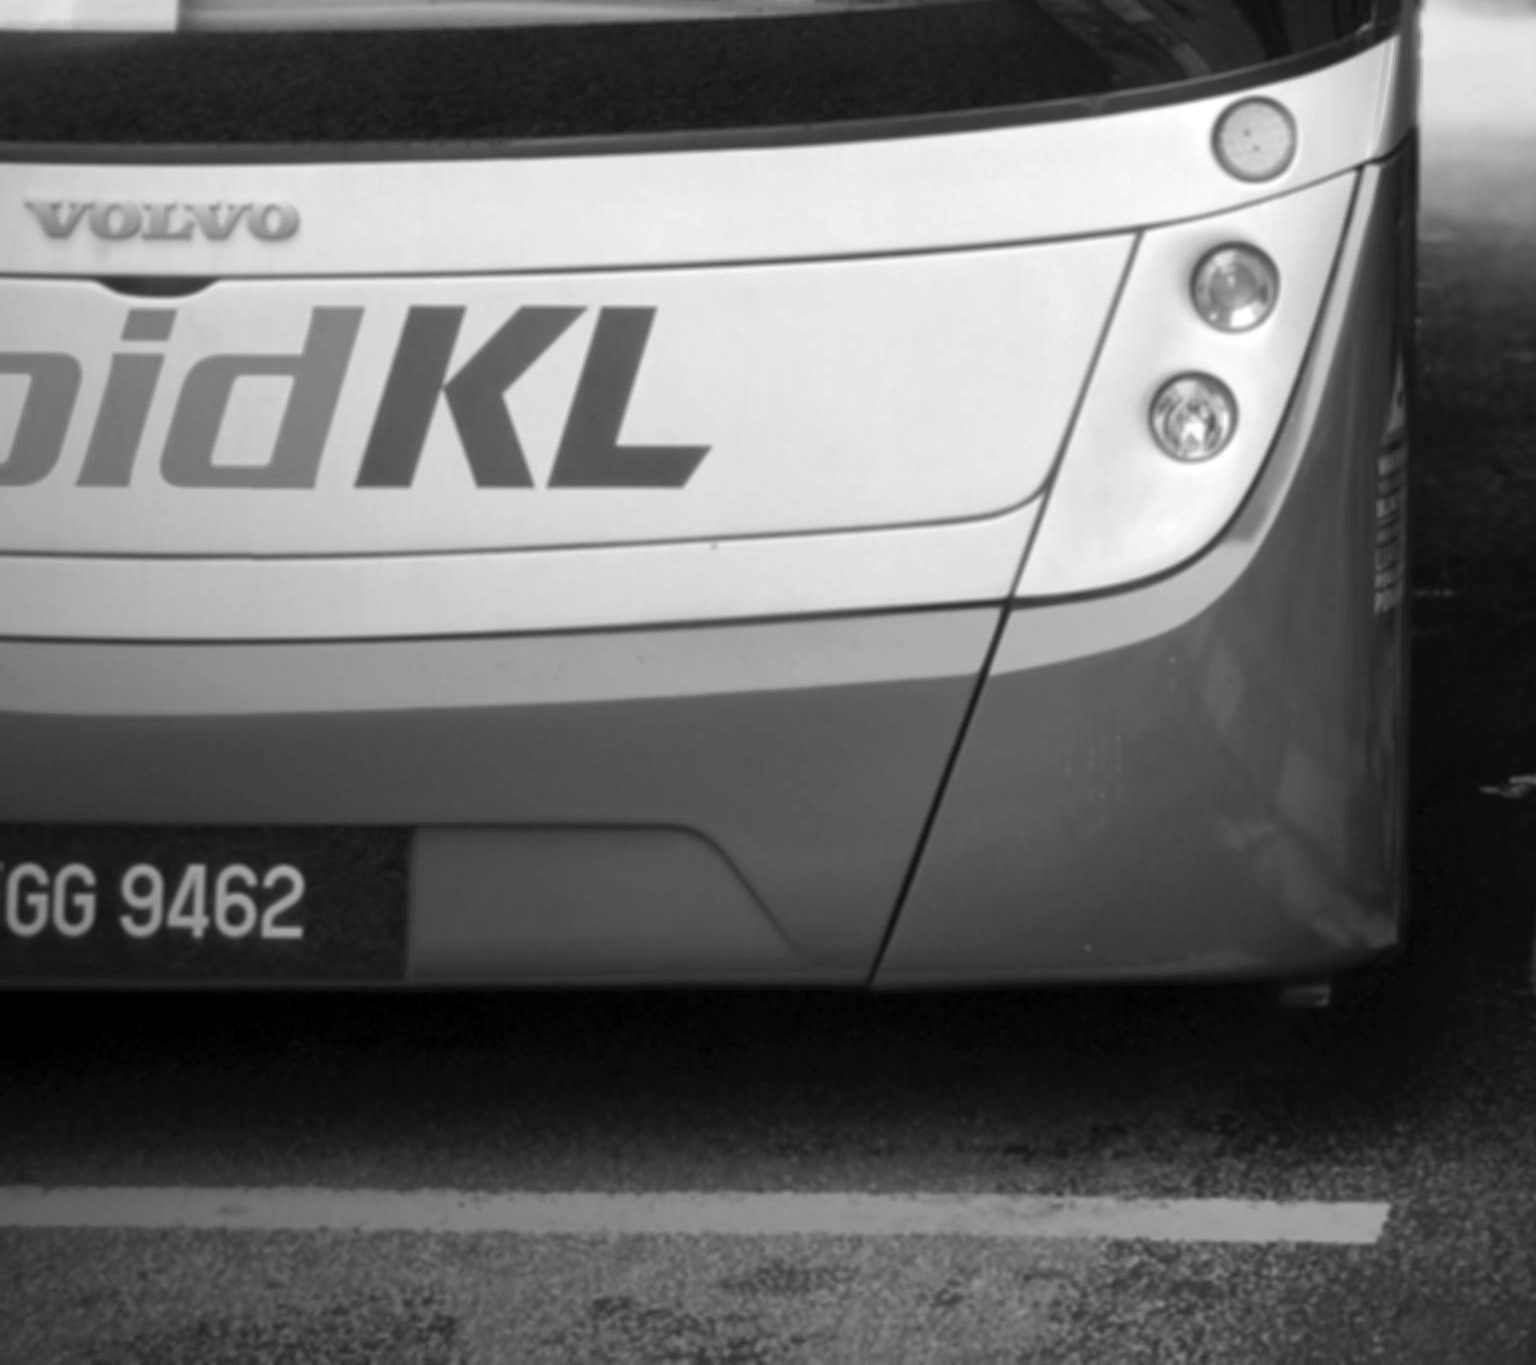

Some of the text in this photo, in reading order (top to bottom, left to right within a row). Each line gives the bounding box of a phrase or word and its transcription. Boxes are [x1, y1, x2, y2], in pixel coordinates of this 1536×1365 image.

[25, 200, 301, 241] VOLVO
[0, 862, 305, 939] GG 9462
